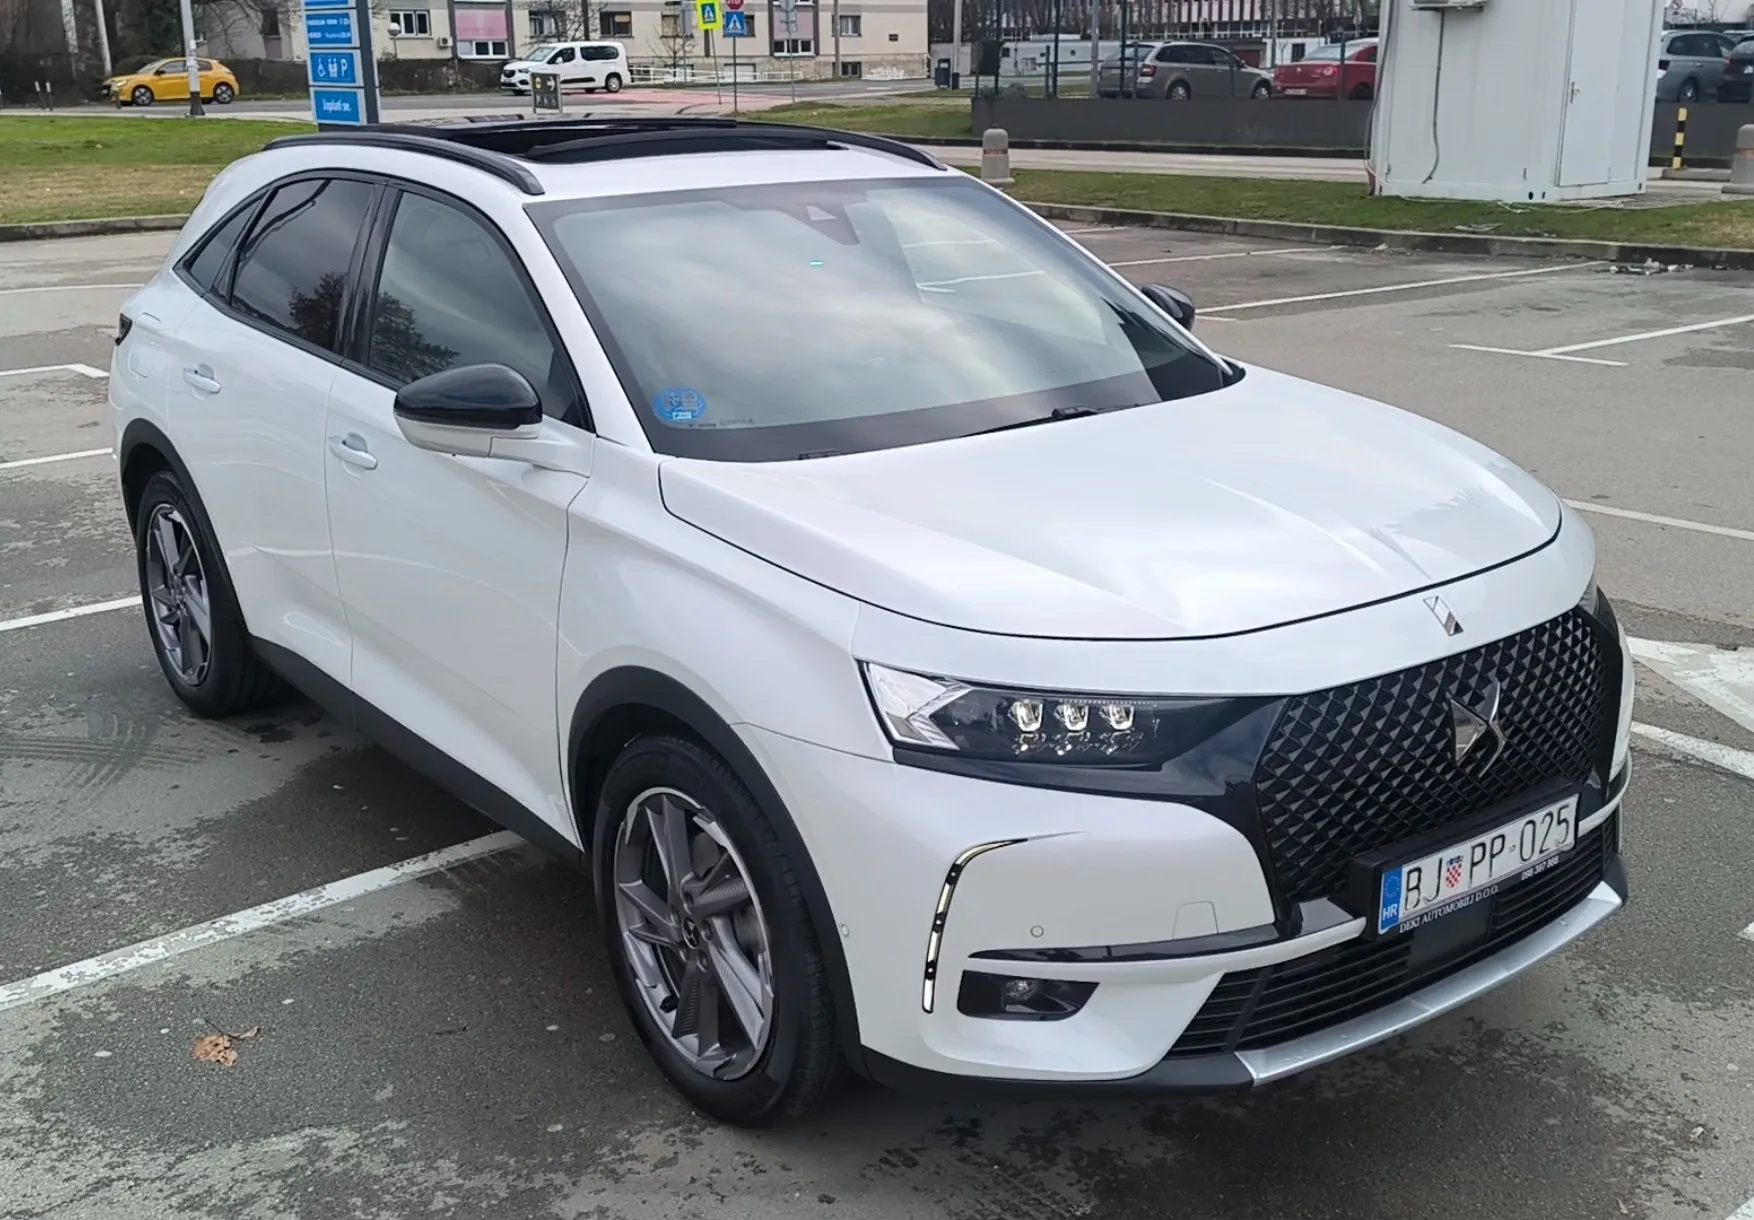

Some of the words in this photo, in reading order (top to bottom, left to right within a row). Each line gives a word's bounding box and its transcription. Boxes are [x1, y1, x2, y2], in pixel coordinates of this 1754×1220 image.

[1404, 858, 1442, 911] BJ
[1382, 904, 1398, 921] HR
[1421, 895, 1474, 925] AUTOMOBILI
